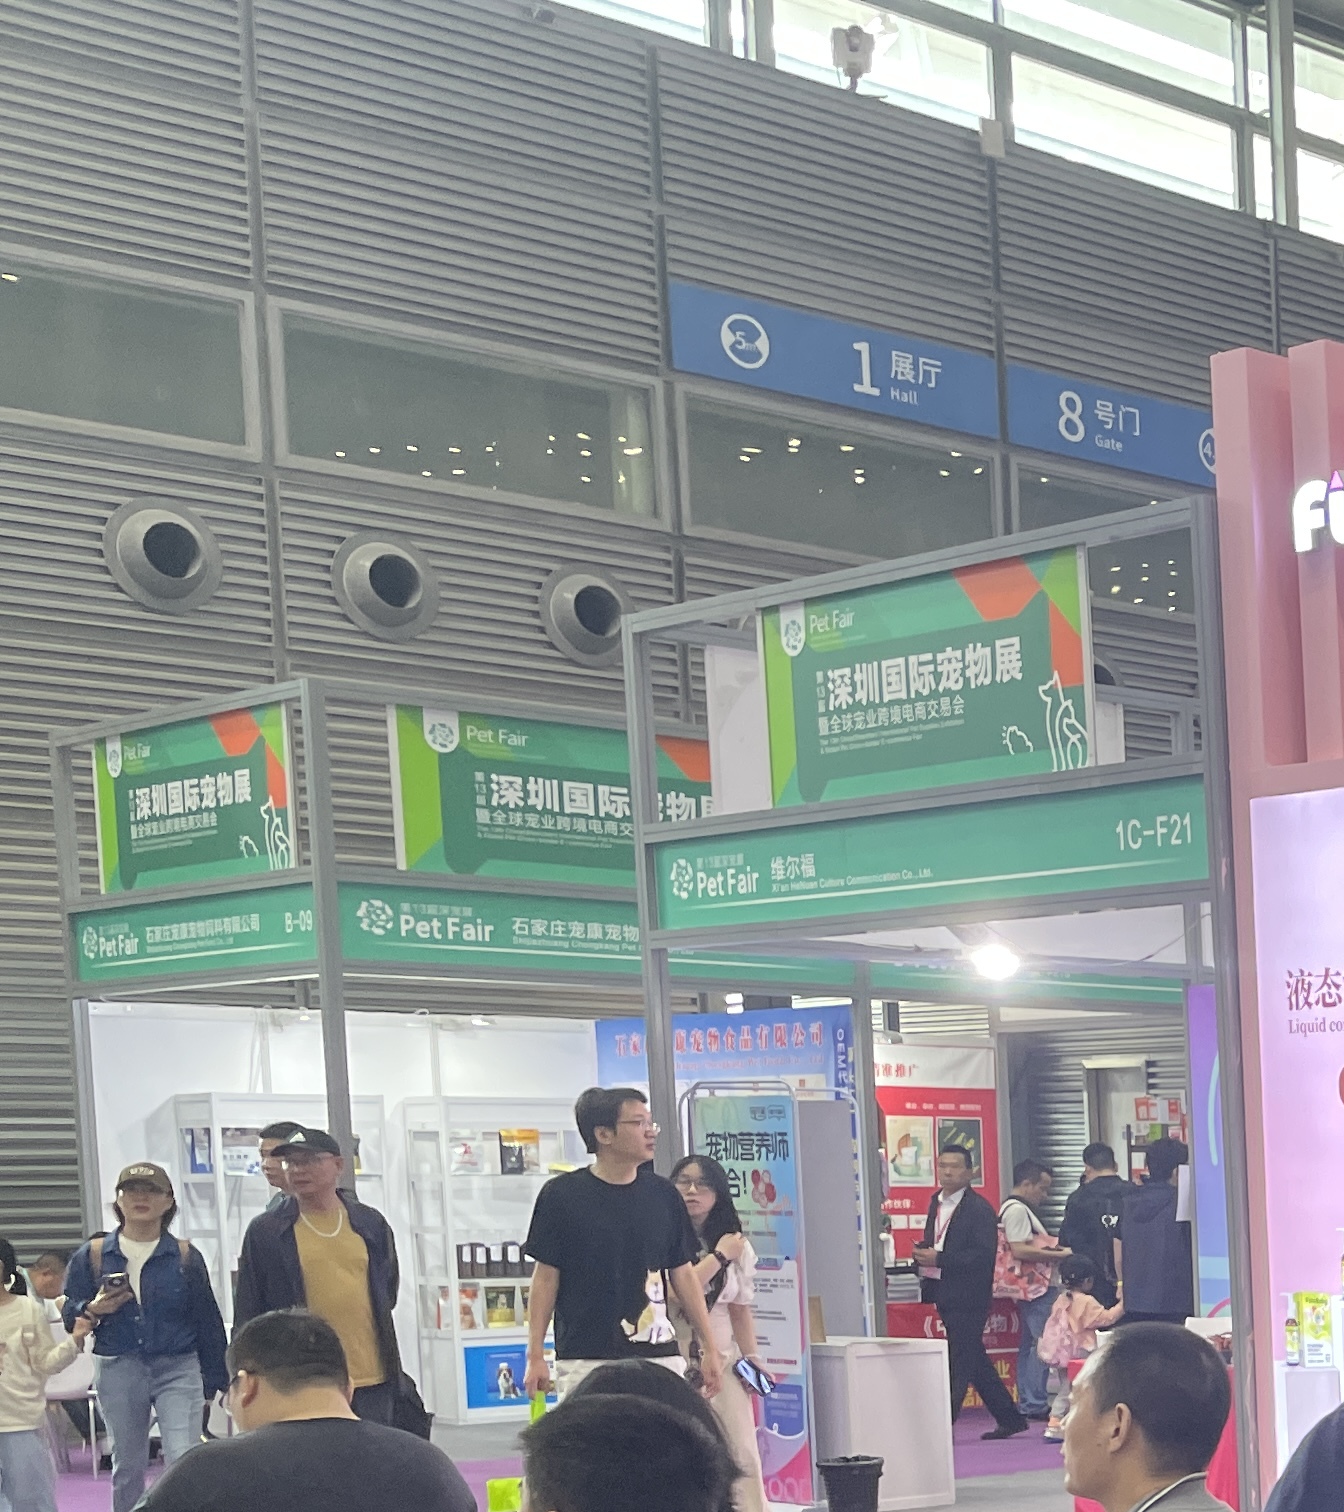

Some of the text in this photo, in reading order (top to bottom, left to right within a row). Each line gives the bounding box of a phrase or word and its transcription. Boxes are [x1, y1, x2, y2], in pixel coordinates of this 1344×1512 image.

[853, 341, 942, 396] 1 展厅
[890, 386, 918, 406] Hall
[1057, 390, 1140, 442] 8 号门
[1094, 434, 1123, 453] Gate
[809, 608, 855, 633] Pet Fair
[827, 636, 1024, 711] 深圳国际宠物展
[466, 725, 529, 748] Pet Fair
[136, 768, 252, 821] 深圳国际宠物展
[1116, 812, 1193, 852] 1C-F21
[697, 864, 760, 898] Pet Fair
[770, 853, 816, 881] 维尔福
[285, 910, 313, 934] B-09
[400, 913, 495, 942] Pet Fair
[511, 917, 640, 943] 石家庄宠康宠物
[1288, 1018, 1327, 1037] Liquid
[705, 1131, 790, 1162] 宠物营养师
